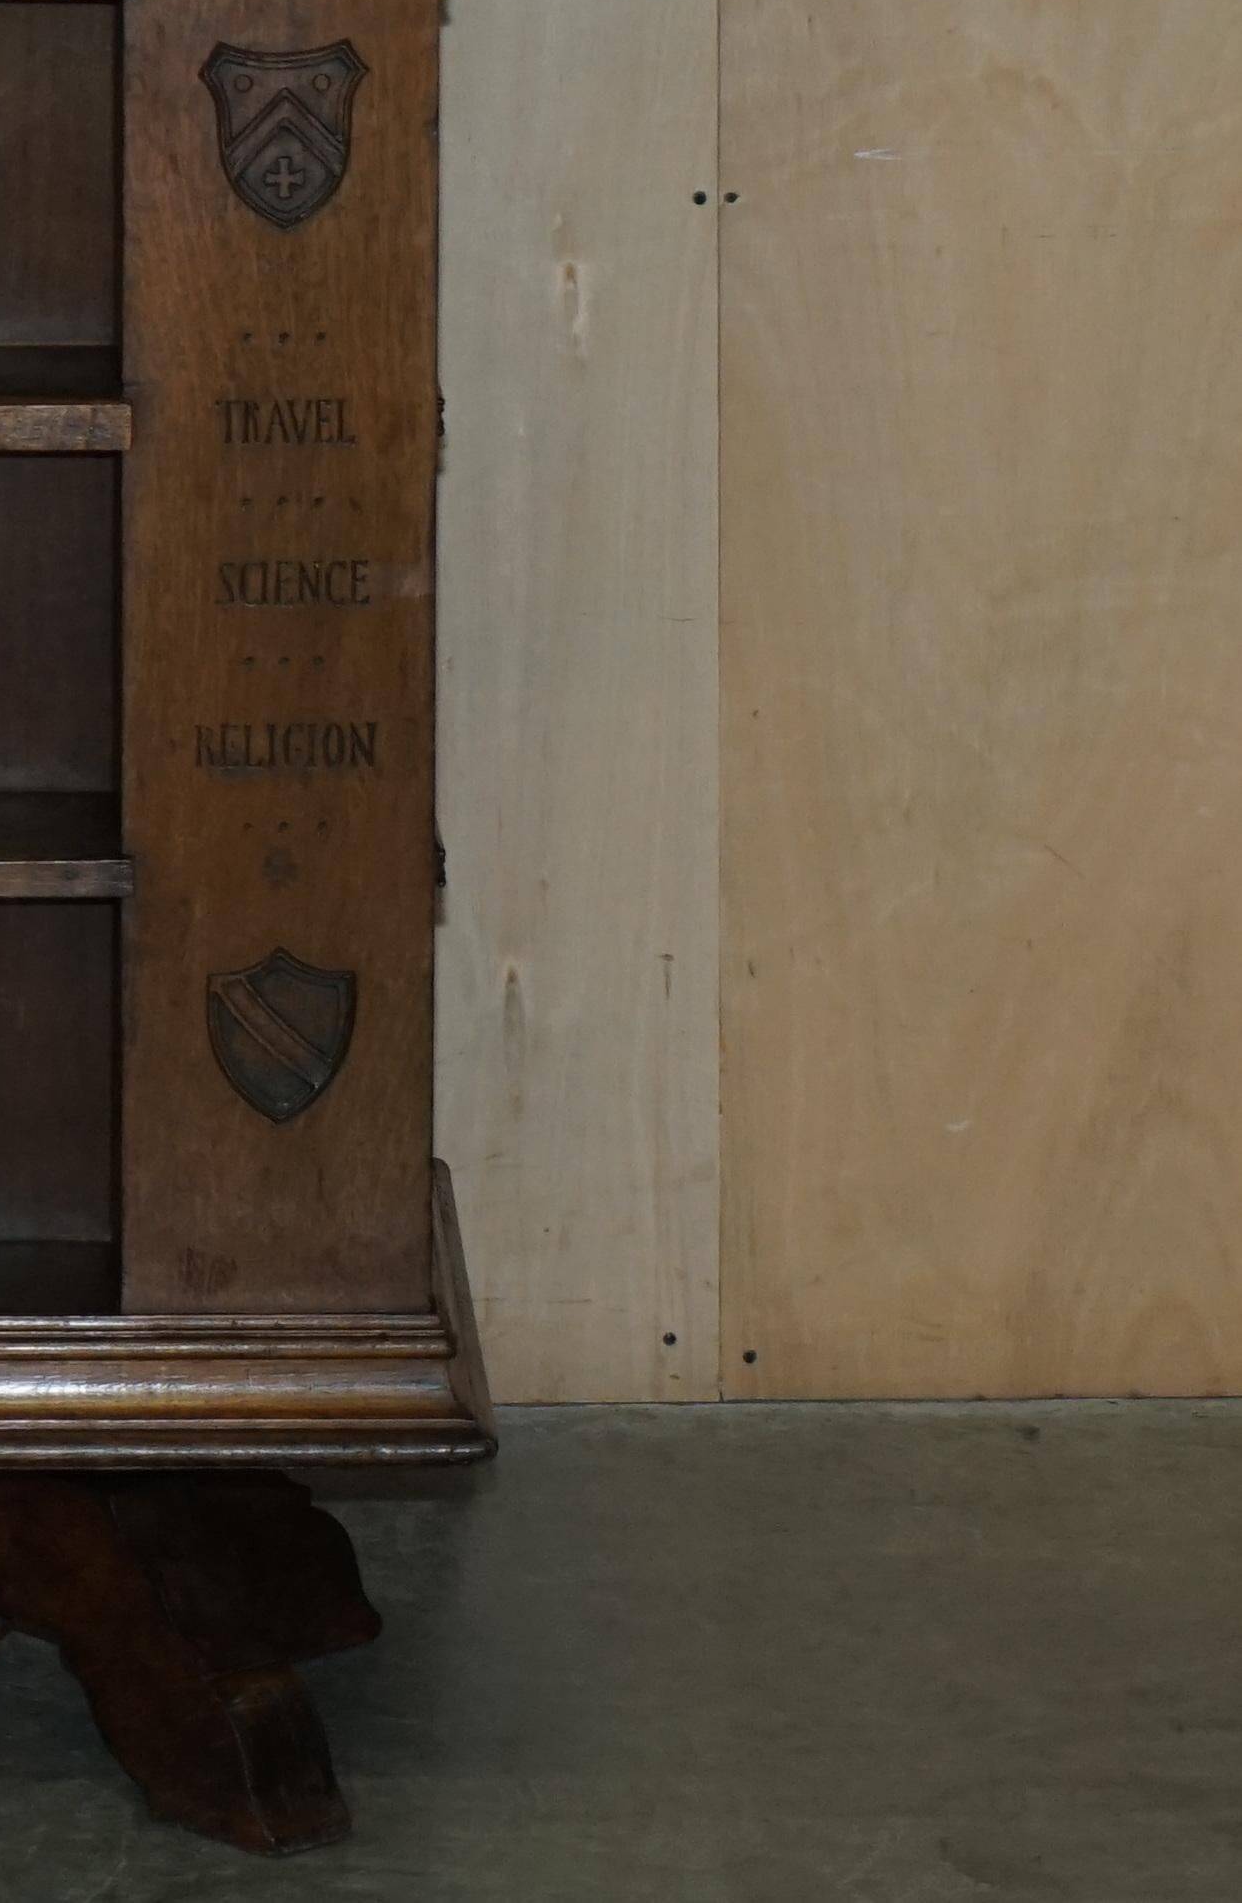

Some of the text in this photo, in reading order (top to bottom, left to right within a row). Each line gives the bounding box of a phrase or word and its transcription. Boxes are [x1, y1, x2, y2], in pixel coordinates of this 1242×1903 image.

[215, 398, 357, 445] TRAVEL
[216, 560, 371, 606] SCIENCE
[194, 721, 377, 769] RELIGION
